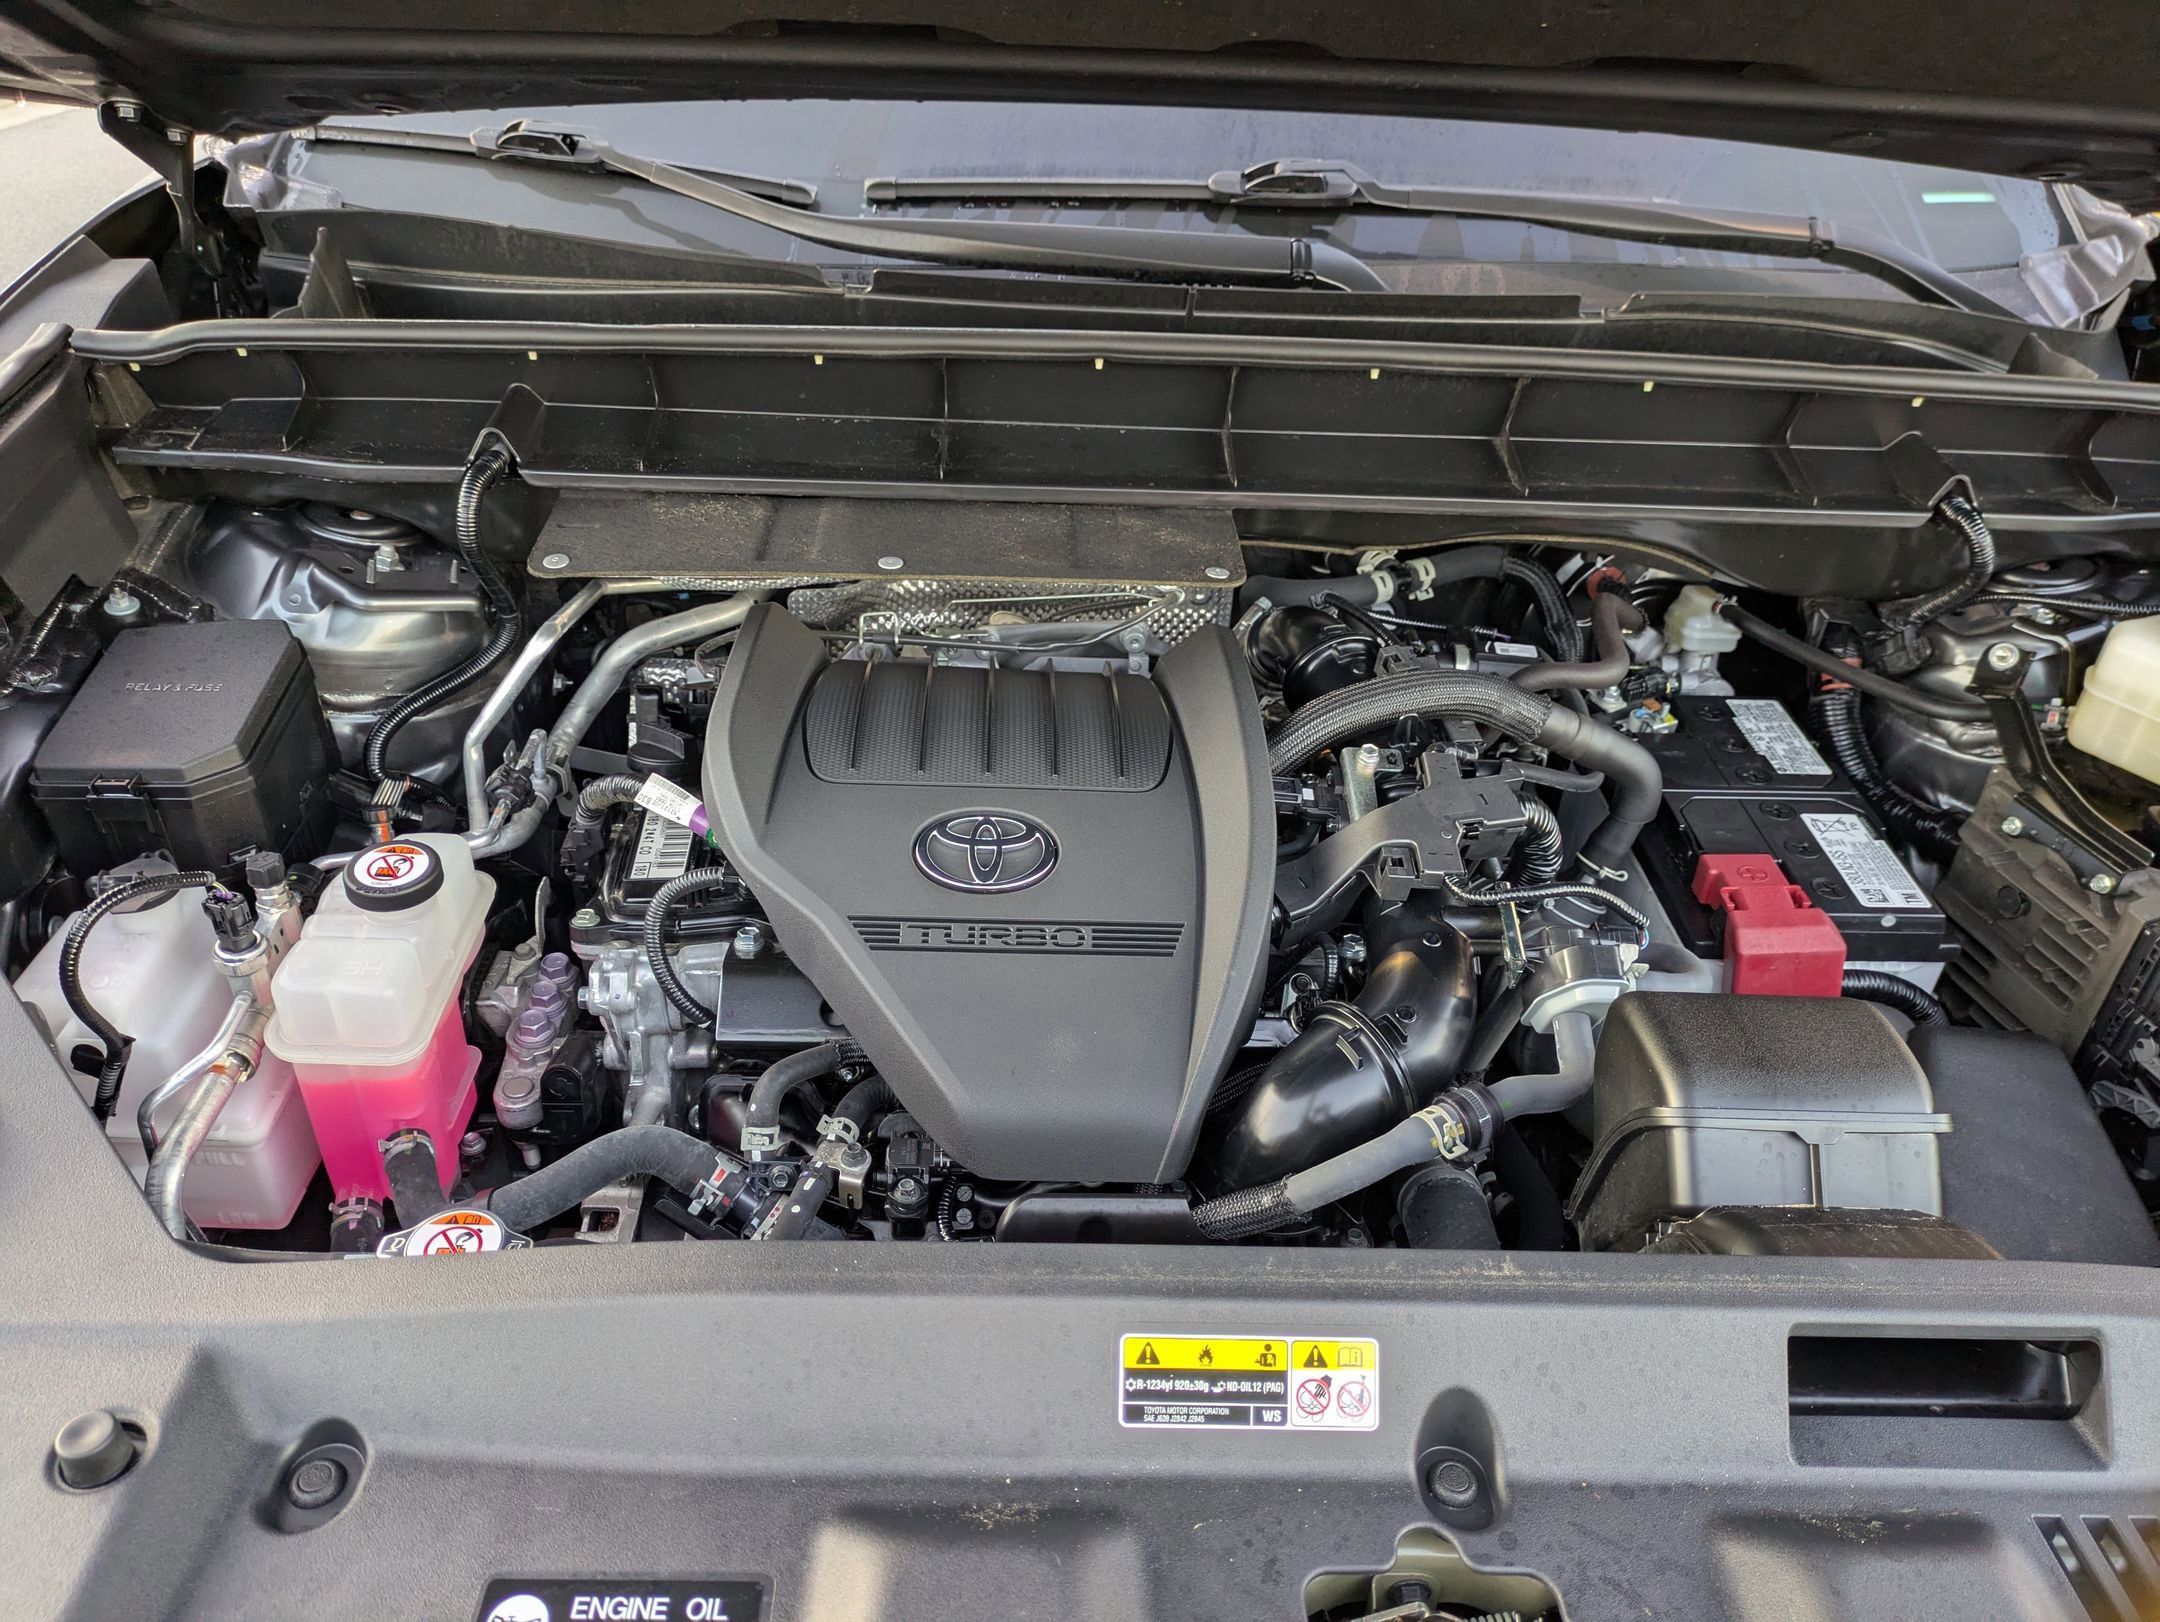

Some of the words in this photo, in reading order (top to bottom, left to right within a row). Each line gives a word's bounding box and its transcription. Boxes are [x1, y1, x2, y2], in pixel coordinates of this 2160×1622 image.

[125, 682, 172, 692] RELAY
[185, 683, 224, 692] FUSE
[906, 924, 1087, 947] TURBO
[1136, 1378, 1174, 1393] R-1234yf
[1174, 1379, 1210, 1393] 920±30g
[1263, 1382, 1285, 1395] (PAG)
[1143, 1406, 1167, 1415] TOYOTA
[1167, 1407, 1188, 1415] MOTOR
[1188, 1407, 1230, 1416] CORPORATION
[1262, 1410, 1282, 1423] WS
[1143, 1414, 1155, 1422] SAE
[569, 1595, 671, 1621] ENGINE
[685, 1596, 729, 1621] OIL
